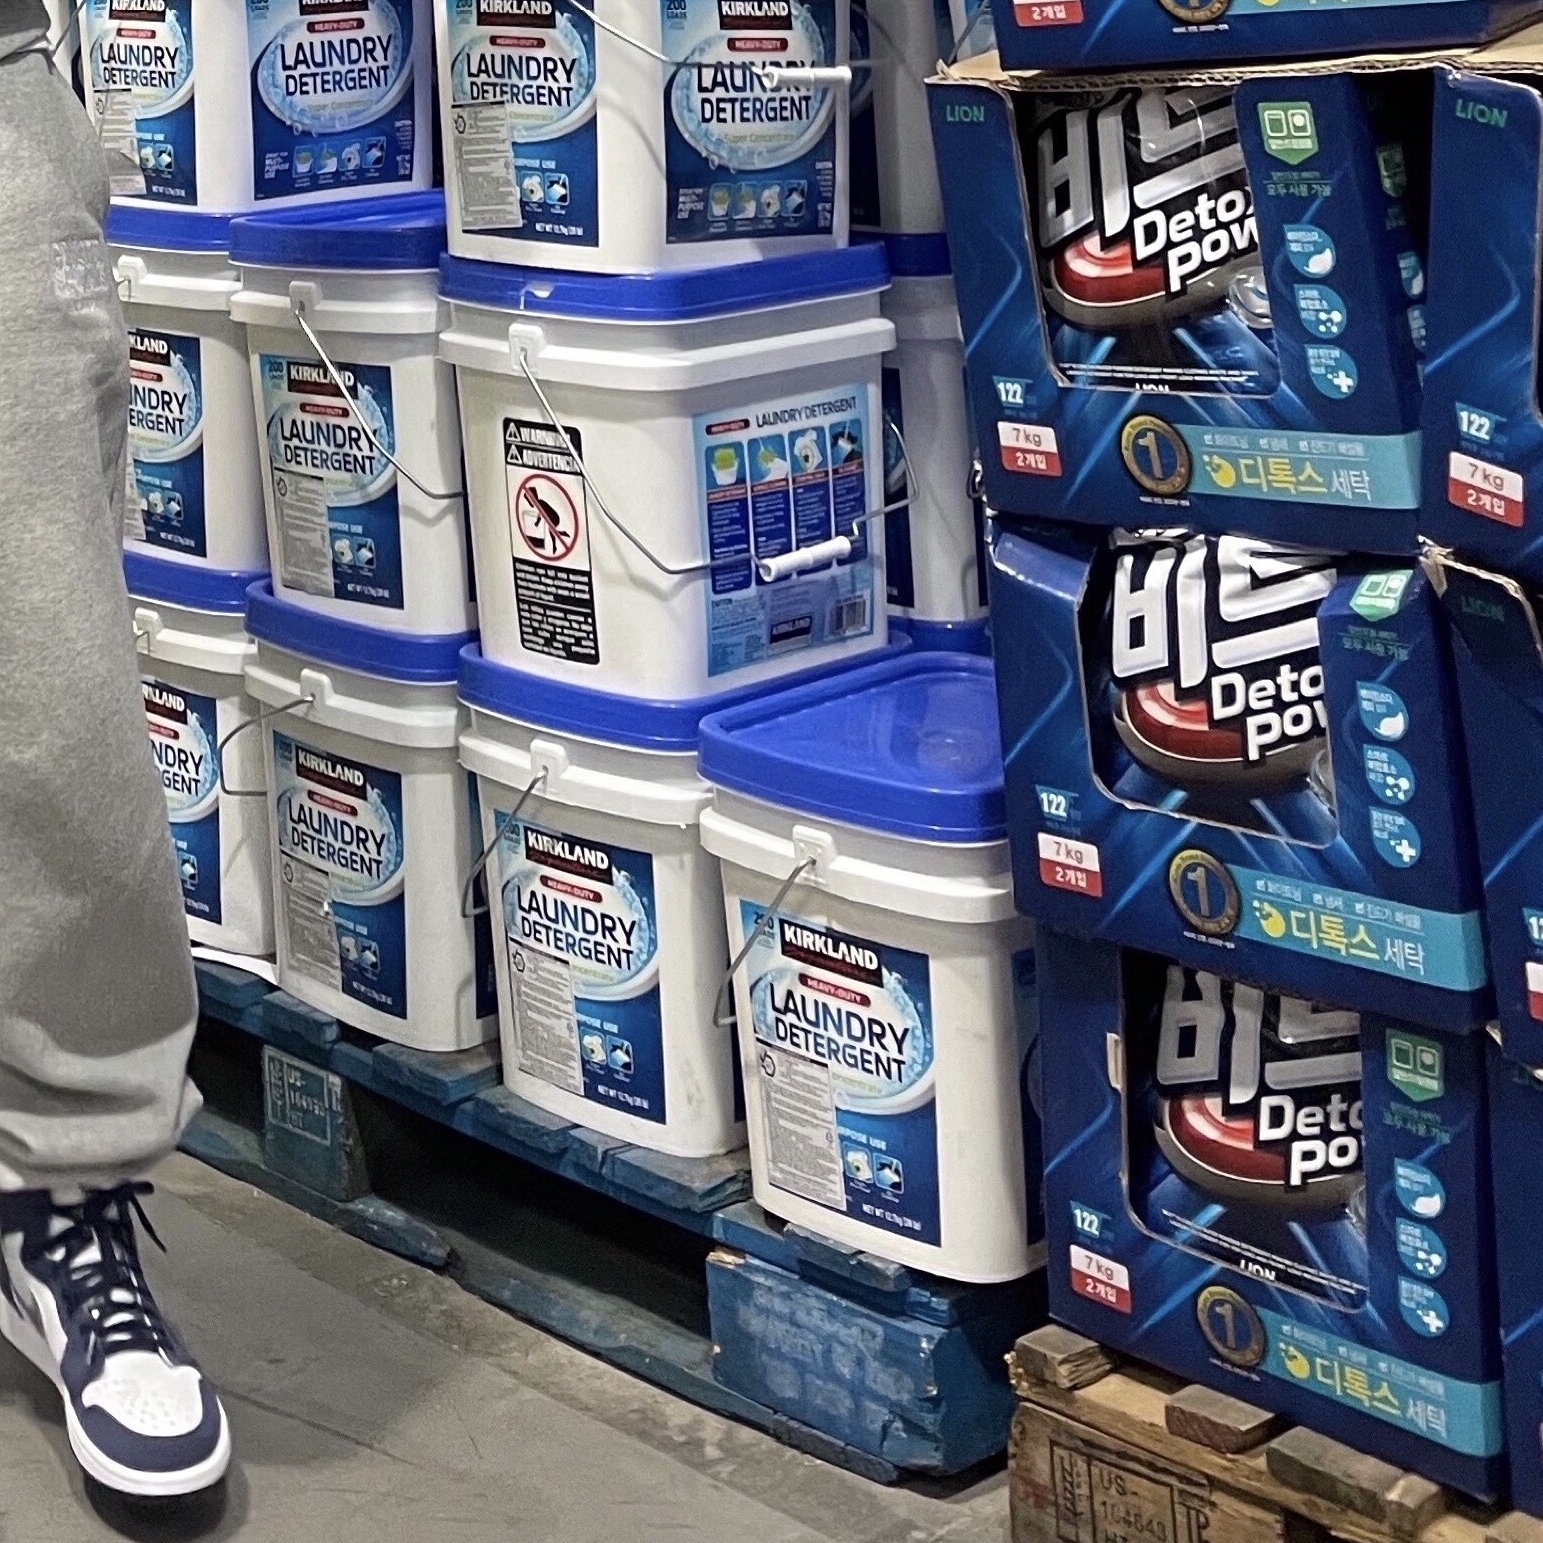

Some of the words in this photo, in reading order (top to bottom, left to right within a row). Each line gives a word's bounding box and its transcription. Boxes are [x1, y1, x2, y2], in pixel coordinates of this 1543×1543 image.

[721, 0, 789, 17] KIRKLAND
[100, 44, 179, 69] LAUNDRY
[280, 36, 392, 72] LAUNDRY
[467, 52, 577, 84] LAUNDRY
[103, 68, 177, 89] DETERGENT
[285, 65, 390, 96] DETERGENT
[470, 82, 573, 108] DETERGENT
[700, 91, 811, 124] DETERGENT
[945, 104, 984, 122] LION
[1455, 99, 1508, 127] LION
[290, 364, 355, 388] KIRKLAND
[804, 397, 856, 420] DETERGENT
[1460, 412, 1491, 441] 122
[280, 417, 378, 453] LAUNDRY
[284, 445, 376, 477] DETERGENT
[1239, 458, 1328, 494] 디톡스
[1331, 469, 1371, 502] 세탁
[298, 749, 365, 786] KIRKLAND
[288, 799, 386, 855] LAUNDRY
[291, 827, 383, 879] DETERGENT
[528, 830, 609, 869] KIRKLAND
[516, 884, 638, 946] LAUNDRY
[521, 914, 634, 971] DETERGENT
[784, 925, 879, 971] KIRKLAND
[1290, 917, 1380, 960] 디톡스
[1384, 938, 1425, 976] 세탁
[770, 983, 910, 1056] LAUNDRY
[775, 1014, 907, 1083] DETERGENT
[1315, 1359, 1401, 1414] 디톡스
[1406, 1402, 1446, 1439] 세탁
